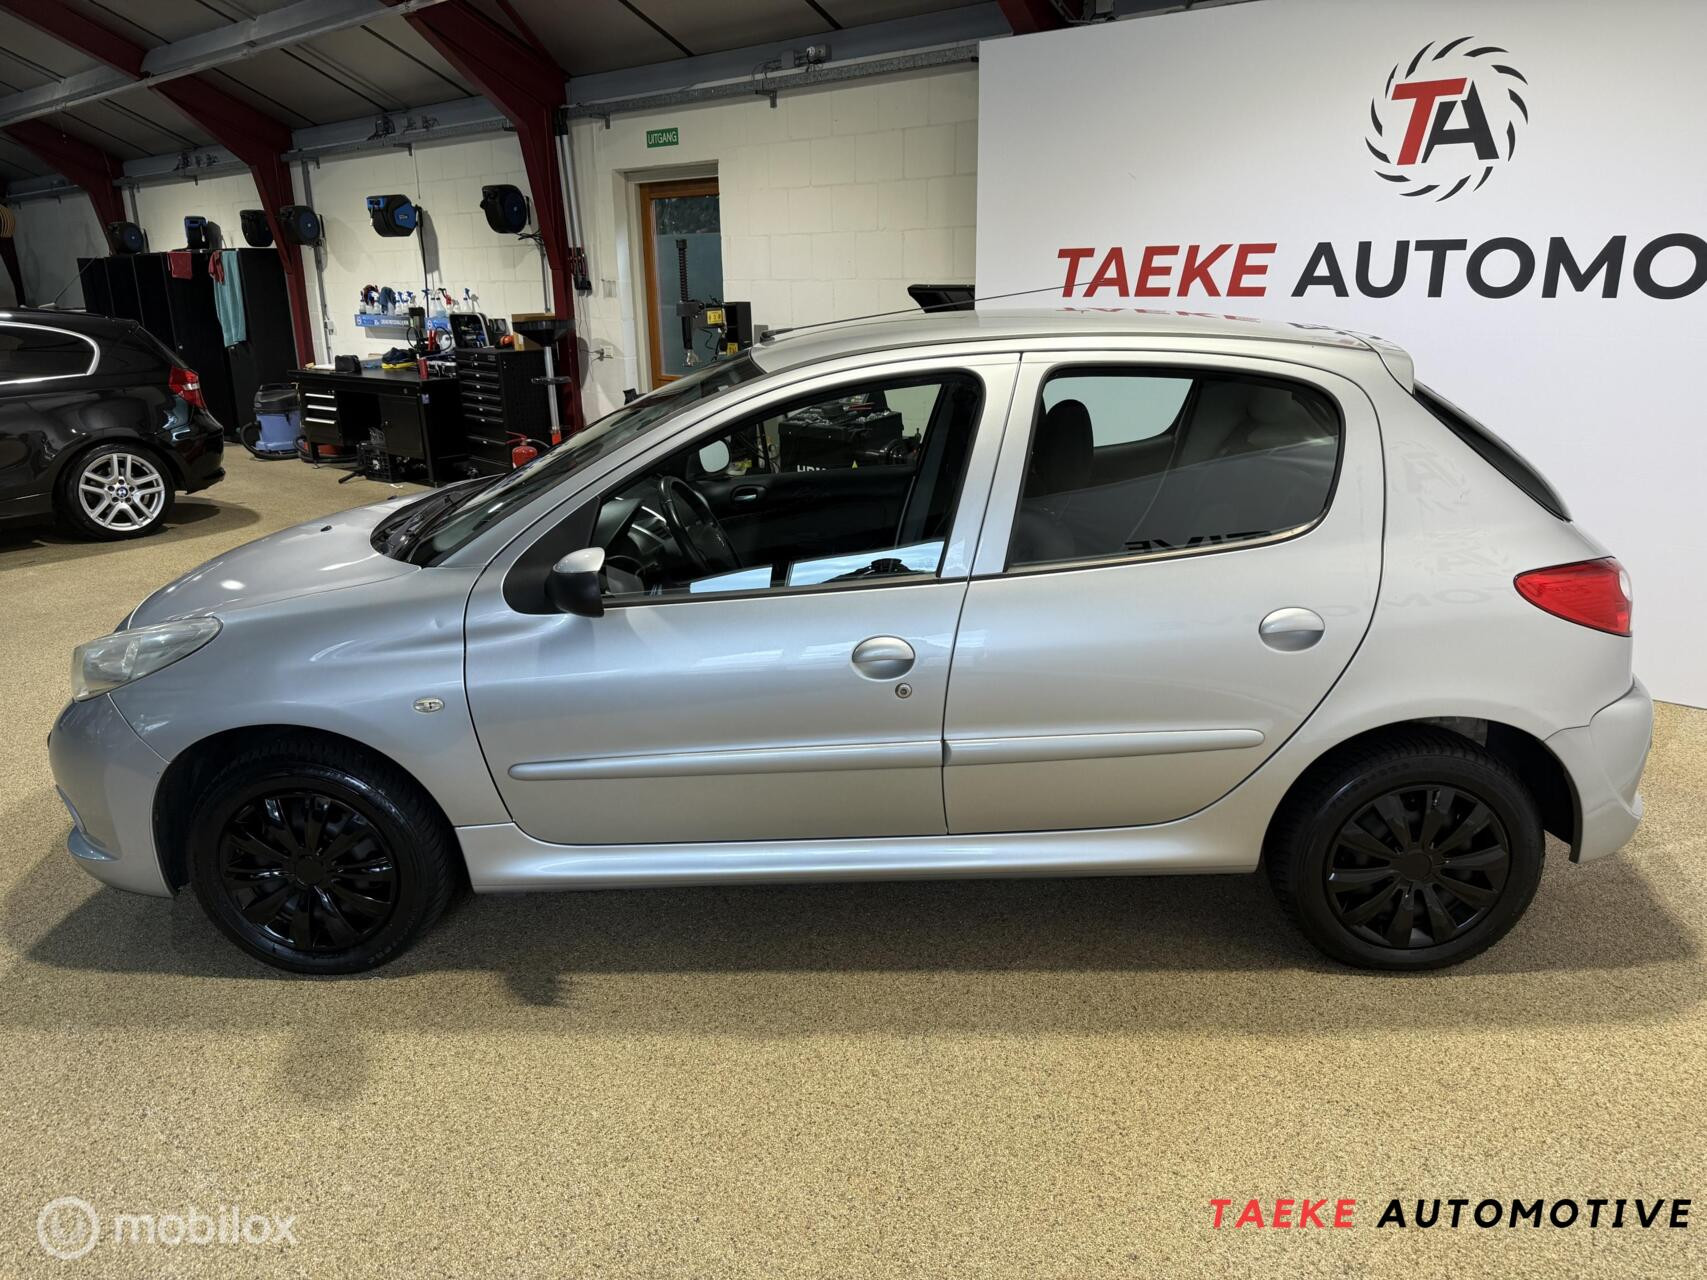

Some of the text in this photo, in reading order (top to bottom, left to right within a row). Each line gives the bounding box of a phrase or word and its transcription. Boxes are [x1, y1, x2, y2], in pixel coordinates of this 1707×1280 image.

[647, 131, 678, 145] UITGANG
[1391, 77, 1500, 166] TA
[1057, 232, 1707, 300] TAEKE AUTOMO
